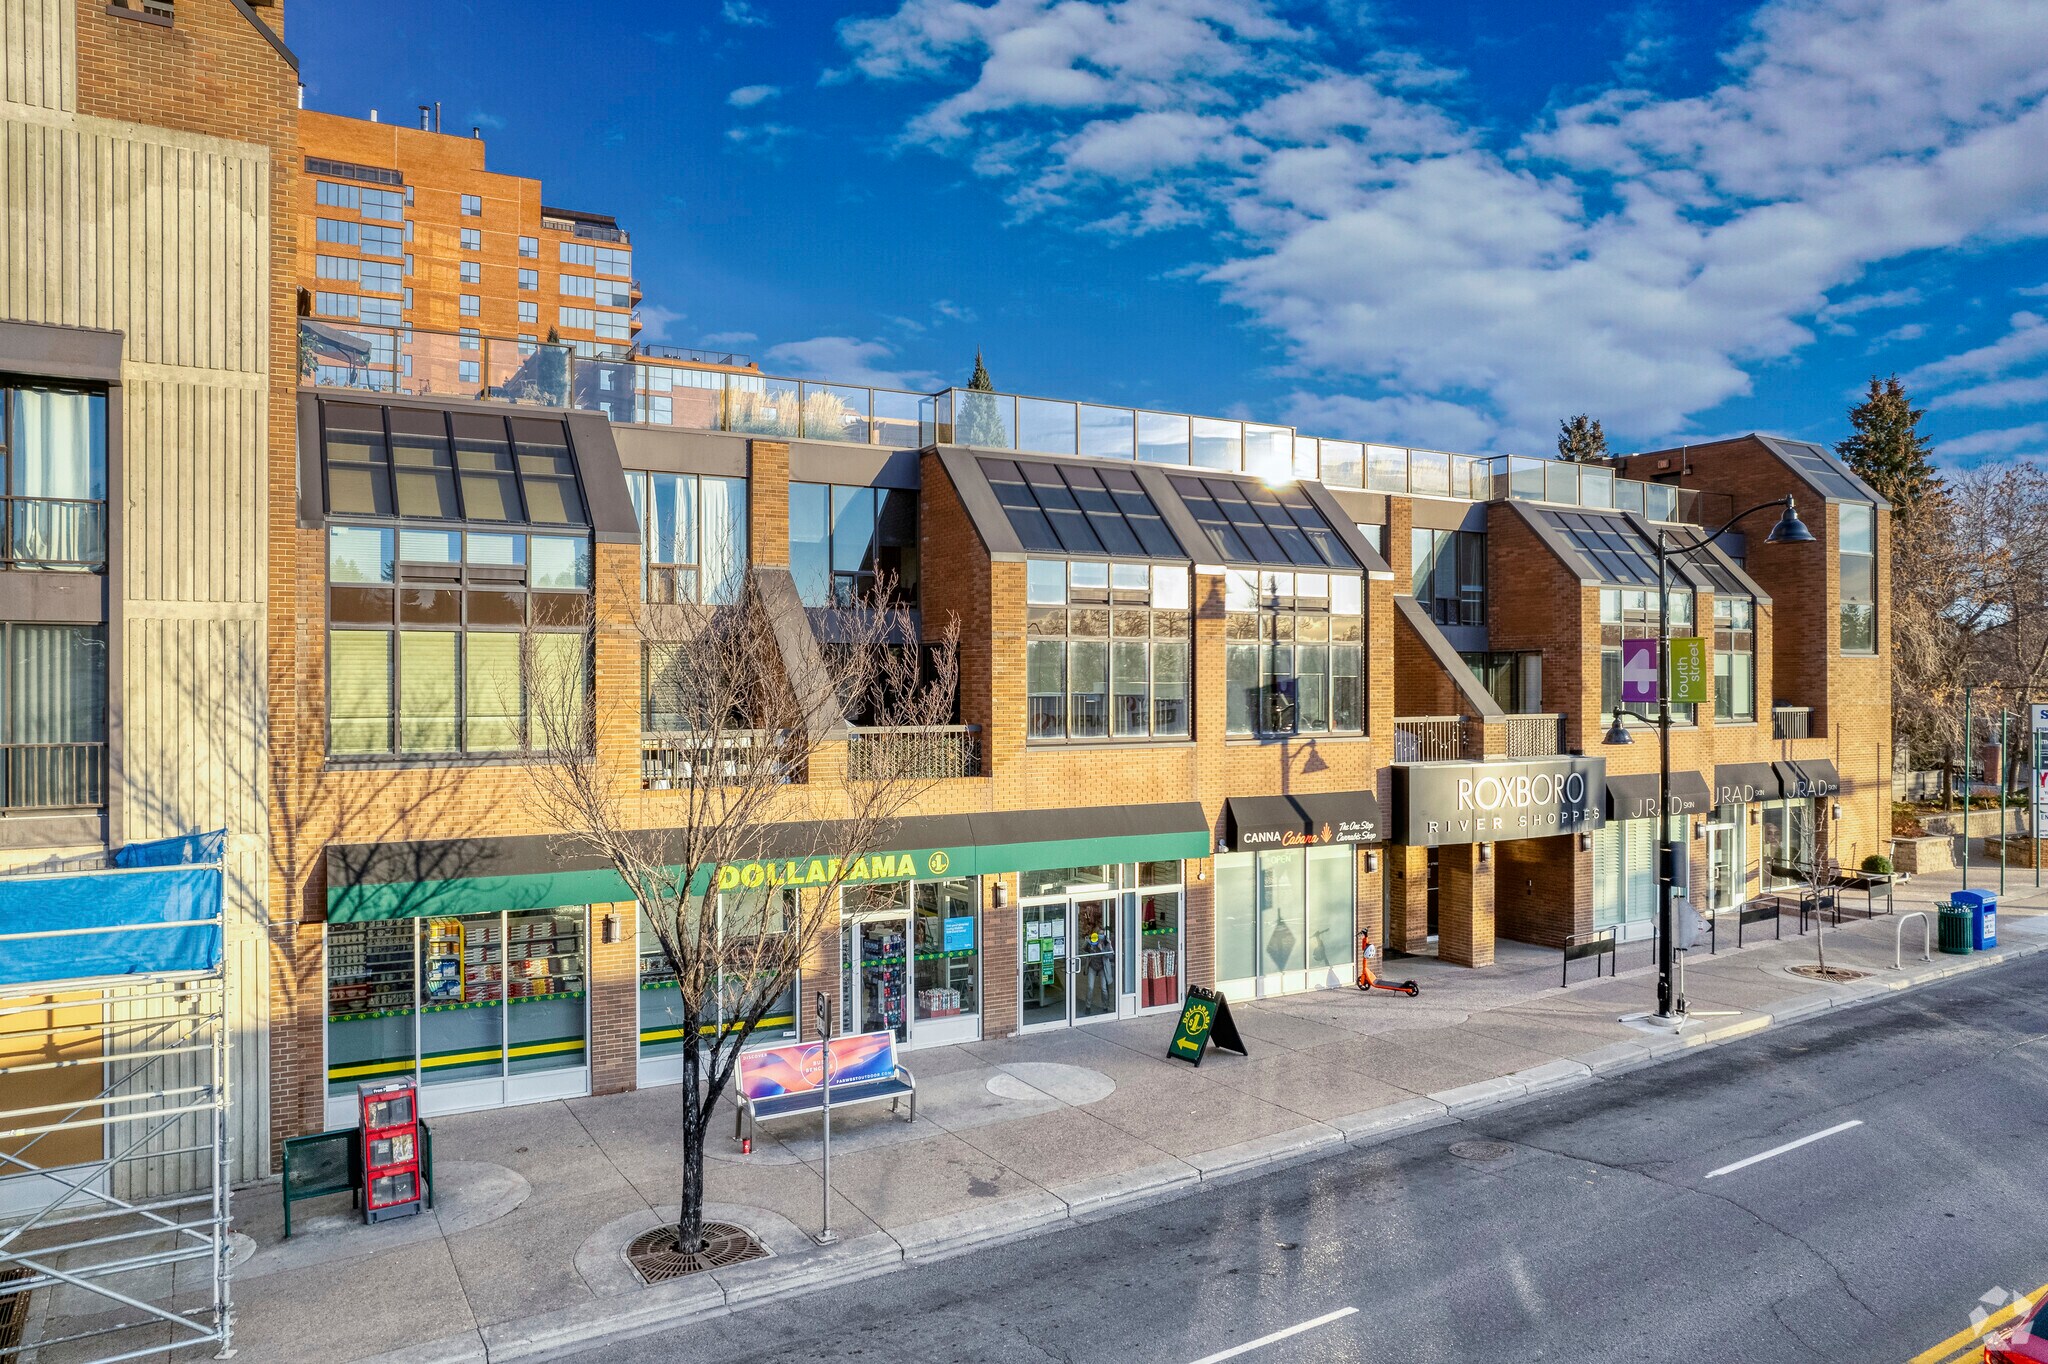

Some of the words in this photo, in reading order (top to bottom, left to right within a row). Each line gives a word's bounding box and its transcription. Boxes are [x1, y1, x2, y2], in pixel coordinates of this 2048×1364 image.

[1624, 648, 1657, 694] 4
[1688, 642, 1699, 682] street
[1677, 657, 1688, 698] fourth
[1457, 772, 1584, 811] ROXBORO
[1714, 784, 1754, 804] JRAD
[1787, 779, 1828, 798] JRAD
[1339, 821, 1350, 831] The
[1350, 821, 1361, 830] One
[1361, 820, 1374, 831] Stop
[1428, 816, 1502, 834] RIVER
[1518, 807, 1600, 828] SHOPPES
[1243, 831, 1281, 844] CANNA
[1281, 830, 1319, 847] Cabana
[1336, 831, 1361, 842] Cannabis
[1361, 831, 1377, 841] Shop
[1271, 854, 1291, 864] OPEN
[718, 854, 917, 890] DOLLARAMA
[1183, 1004, 1211, 1029] DOLLARAMA
